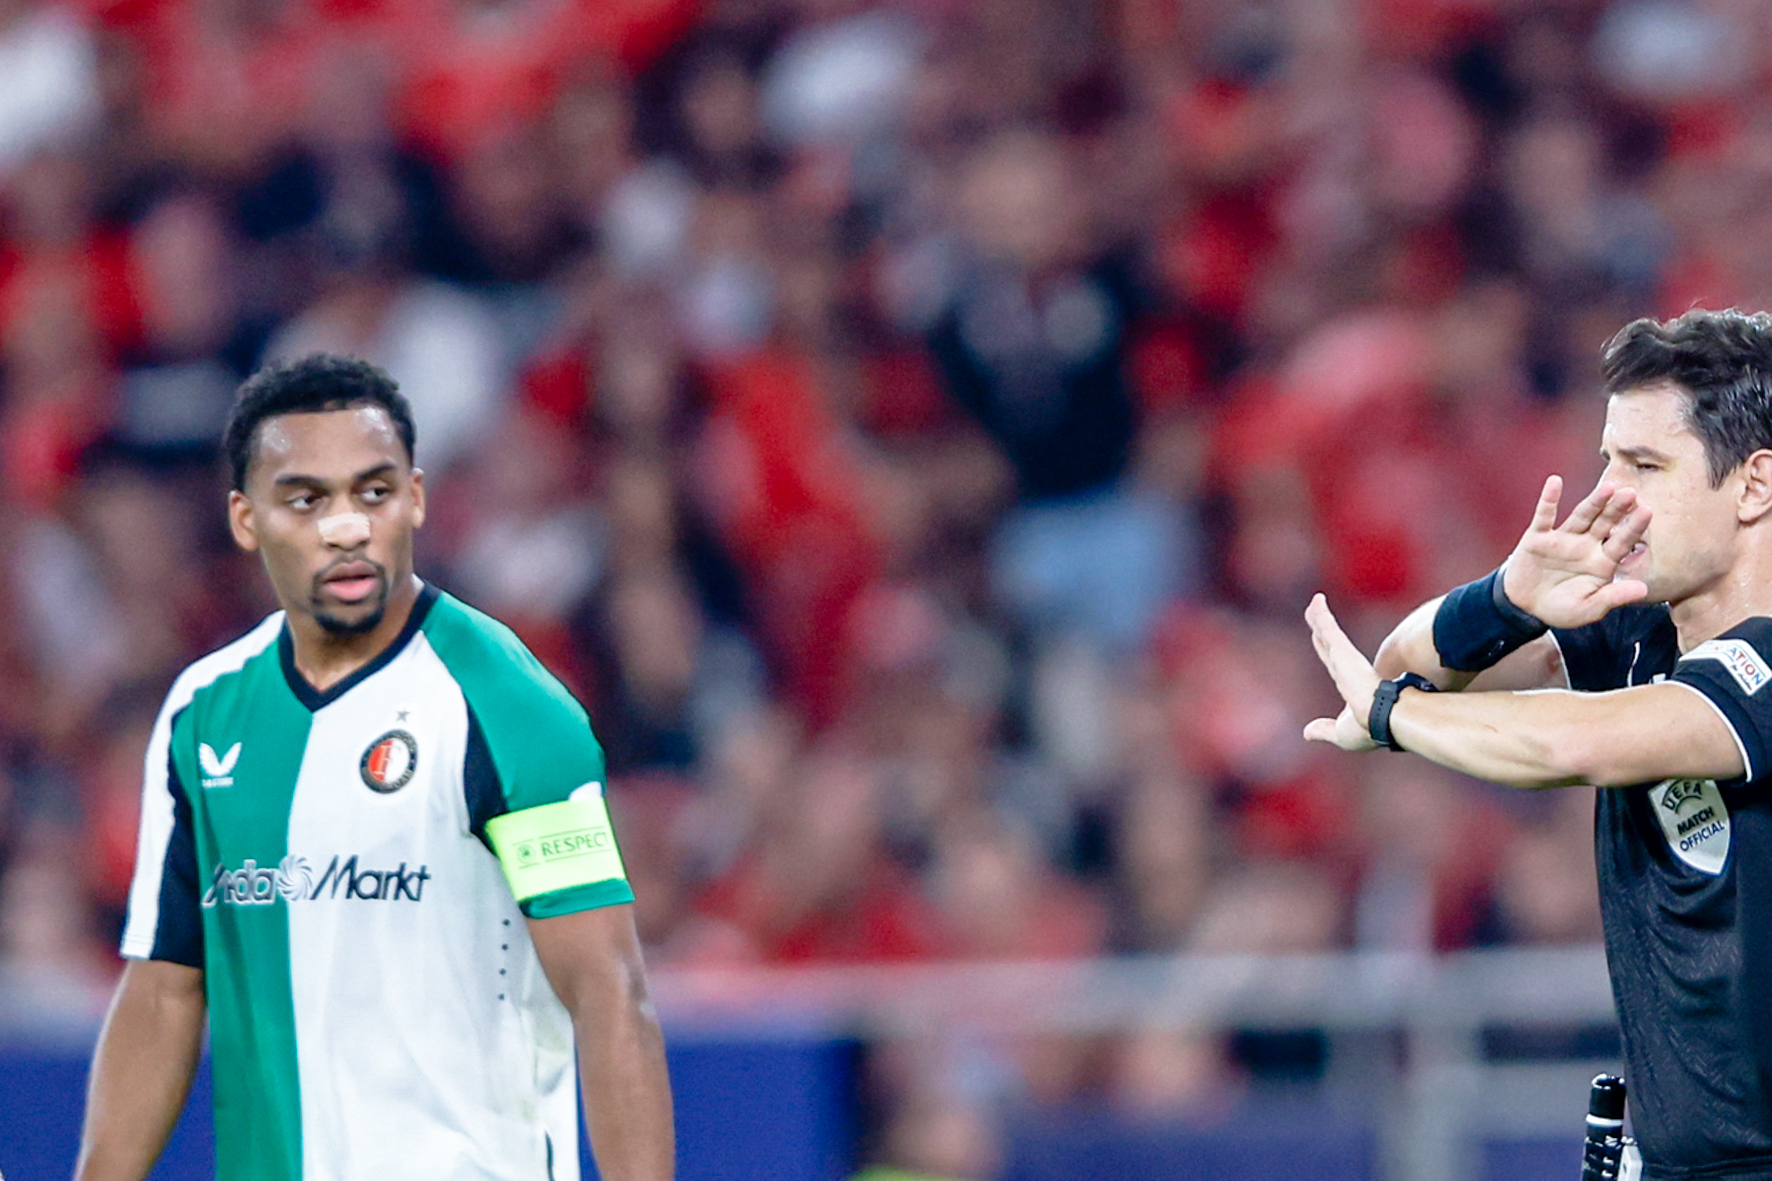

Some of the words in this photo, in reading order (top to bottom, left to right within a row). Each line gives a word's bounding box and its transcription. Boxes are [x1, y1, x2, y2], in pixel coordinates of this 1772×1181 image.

[1663, 781, 1703, 811] UEFA
[1677, 806, 1714, 835] MATCH
[1680, 820, 1726, 851] OFFICIAL
[310, 854, 431, 902] Markt
